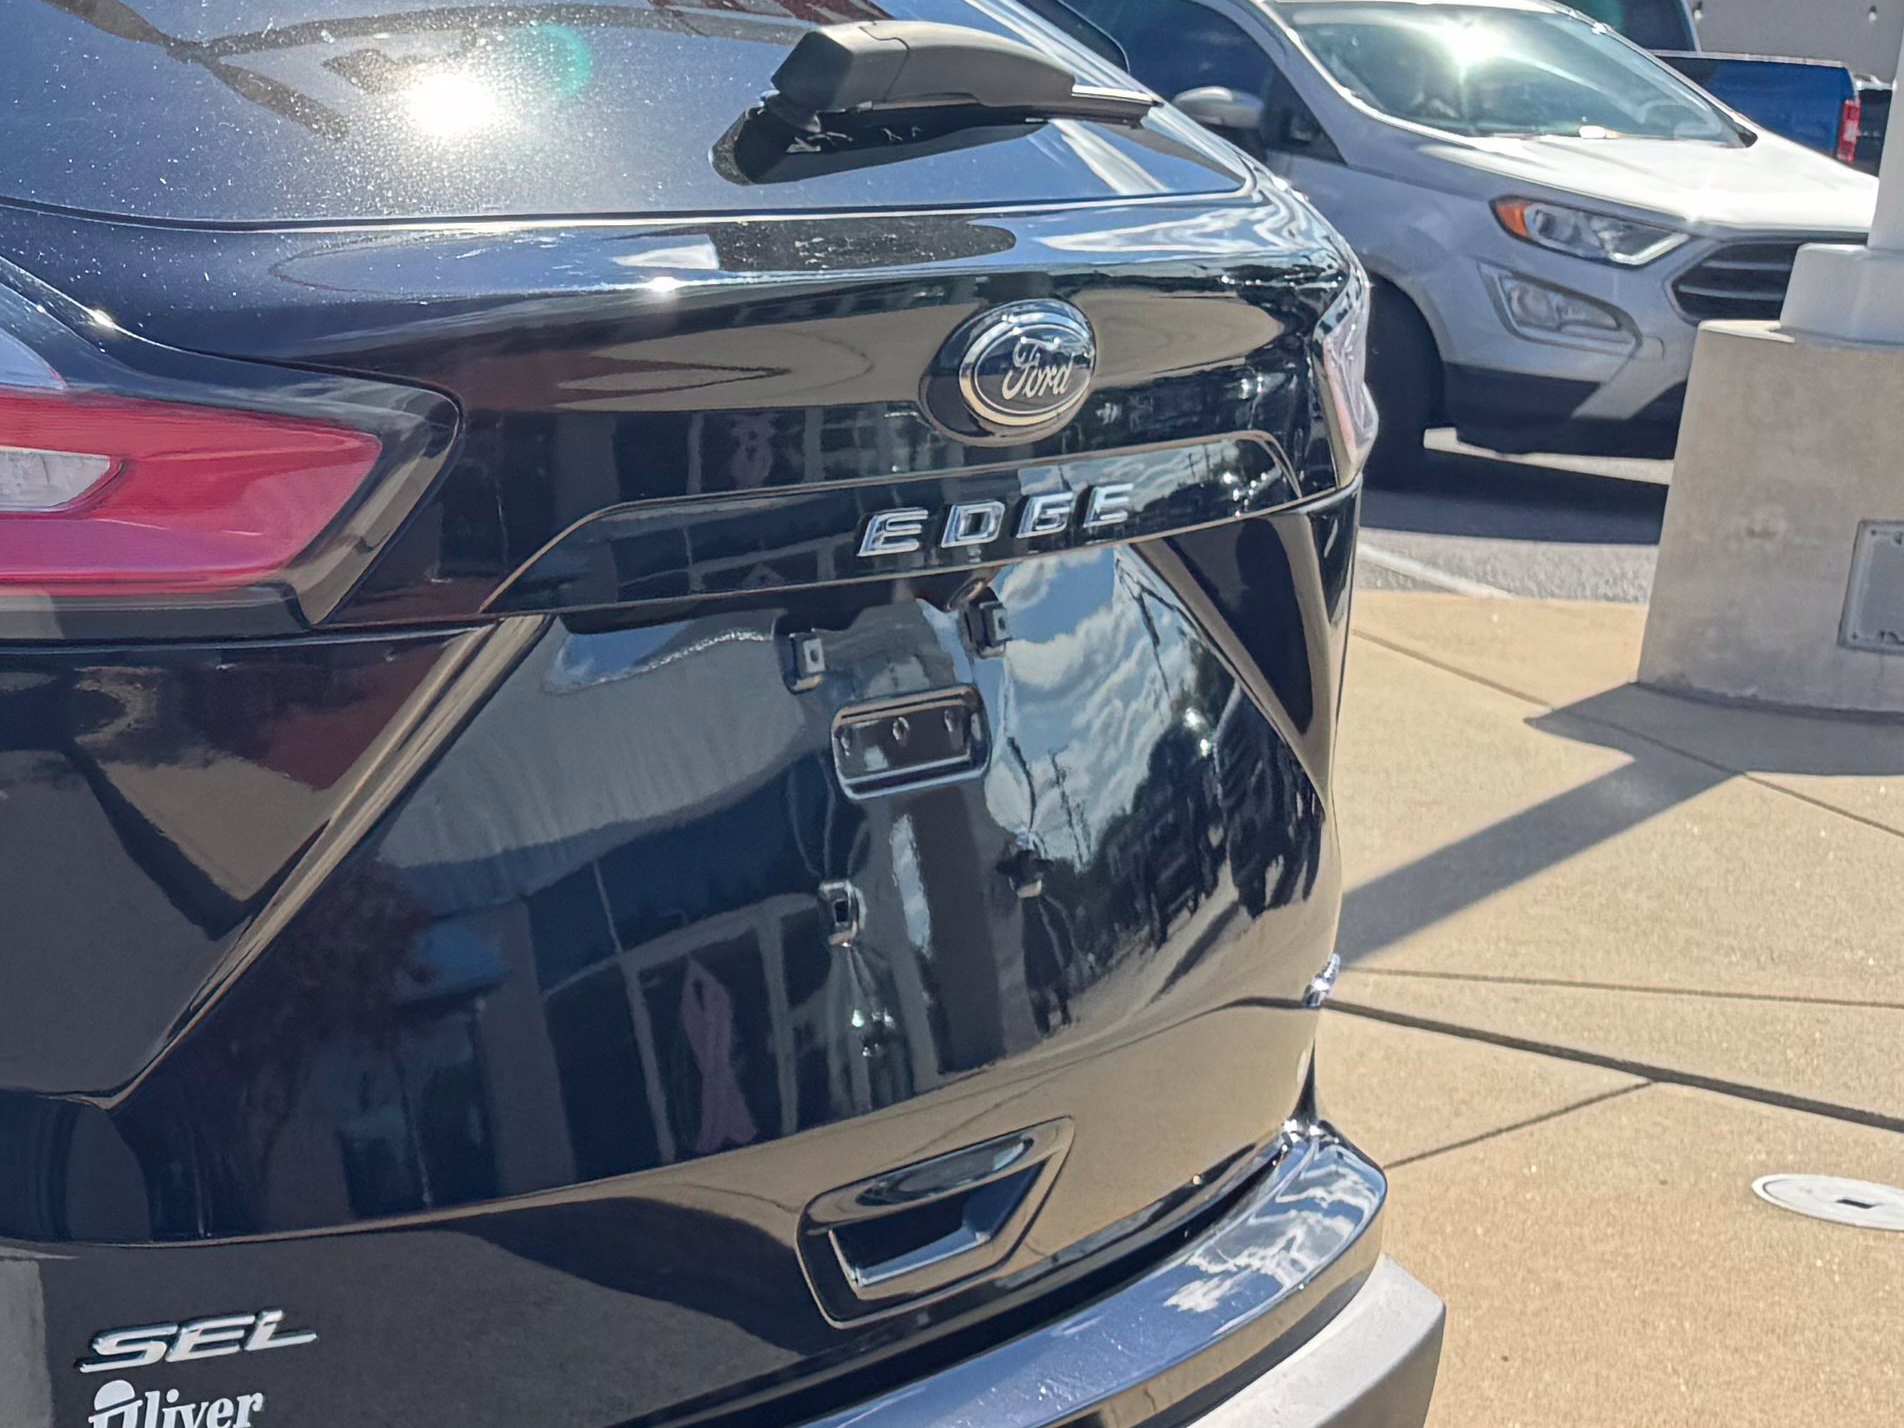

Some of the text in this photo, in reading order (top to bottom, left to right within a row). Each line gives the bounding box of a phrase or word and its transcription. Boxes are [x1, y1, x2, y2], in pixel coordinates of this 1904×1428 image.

[1002, 336, 1074, 400] Ford
[857, 482, 1134, 558] EDGE
[77, 1309, 318, 1373] SEL
